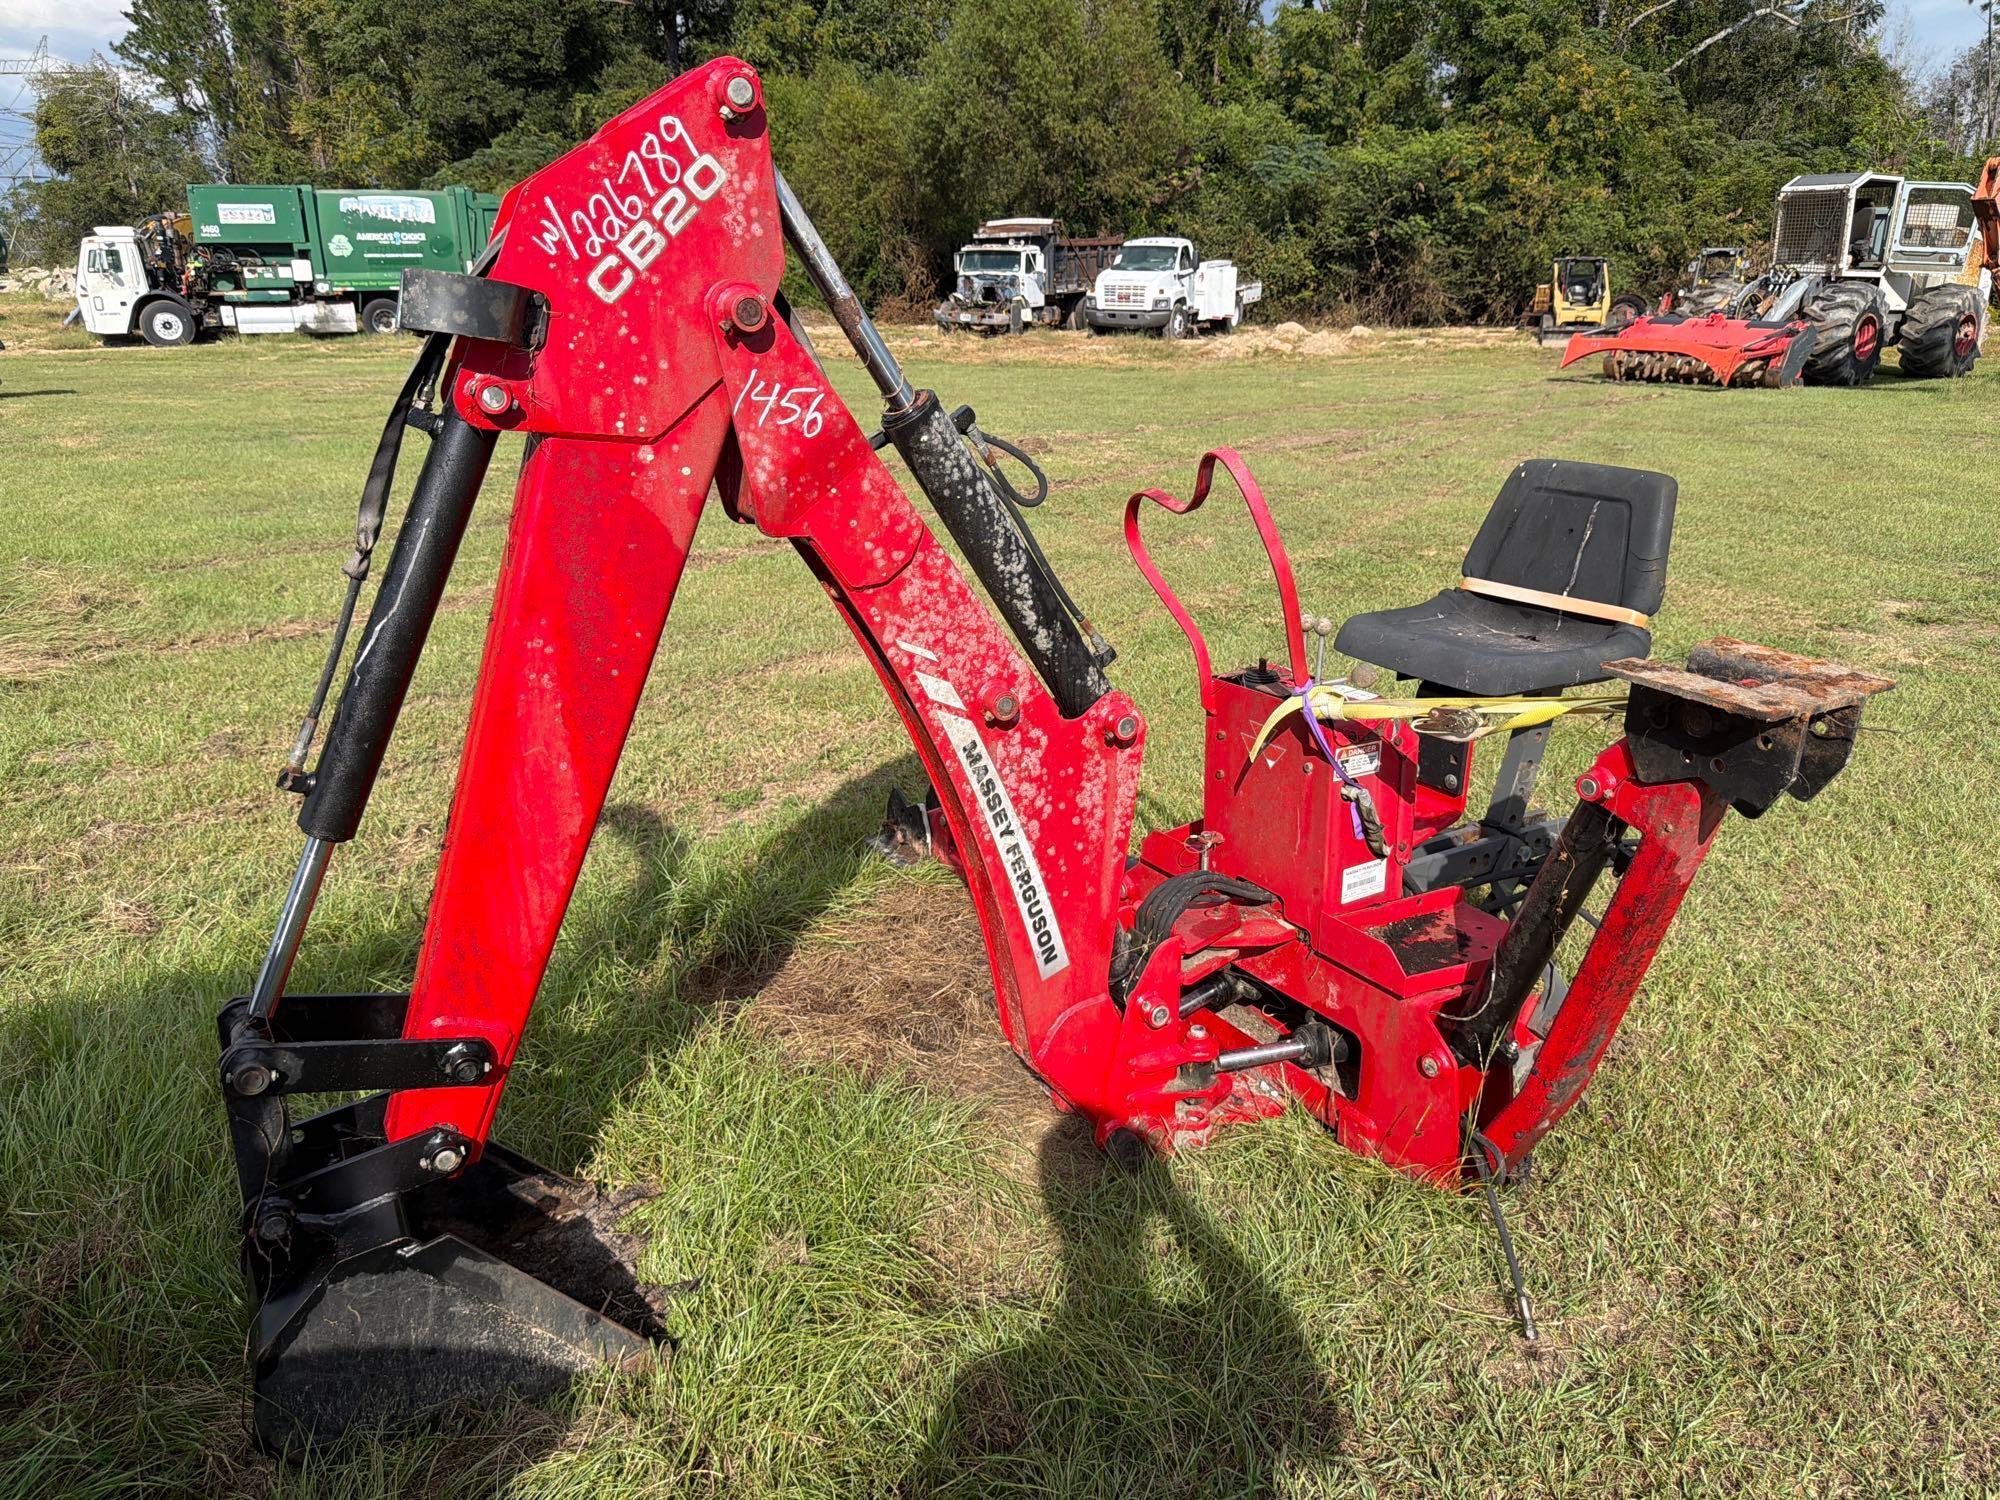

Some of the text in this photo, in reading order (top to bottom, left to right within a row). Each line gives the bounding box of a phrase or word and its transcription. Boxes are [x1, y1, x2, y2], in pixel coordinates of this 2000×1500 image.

[356, 232, 427, 241] AMERICA'S CHOICE
[587, 152, 728, 304] CB20
[732, 368, 825, 438] 1456
[1348, 745, 1377, 756] DANGER
[962, 739, 1059, 966] MASSEY FERGUSON
